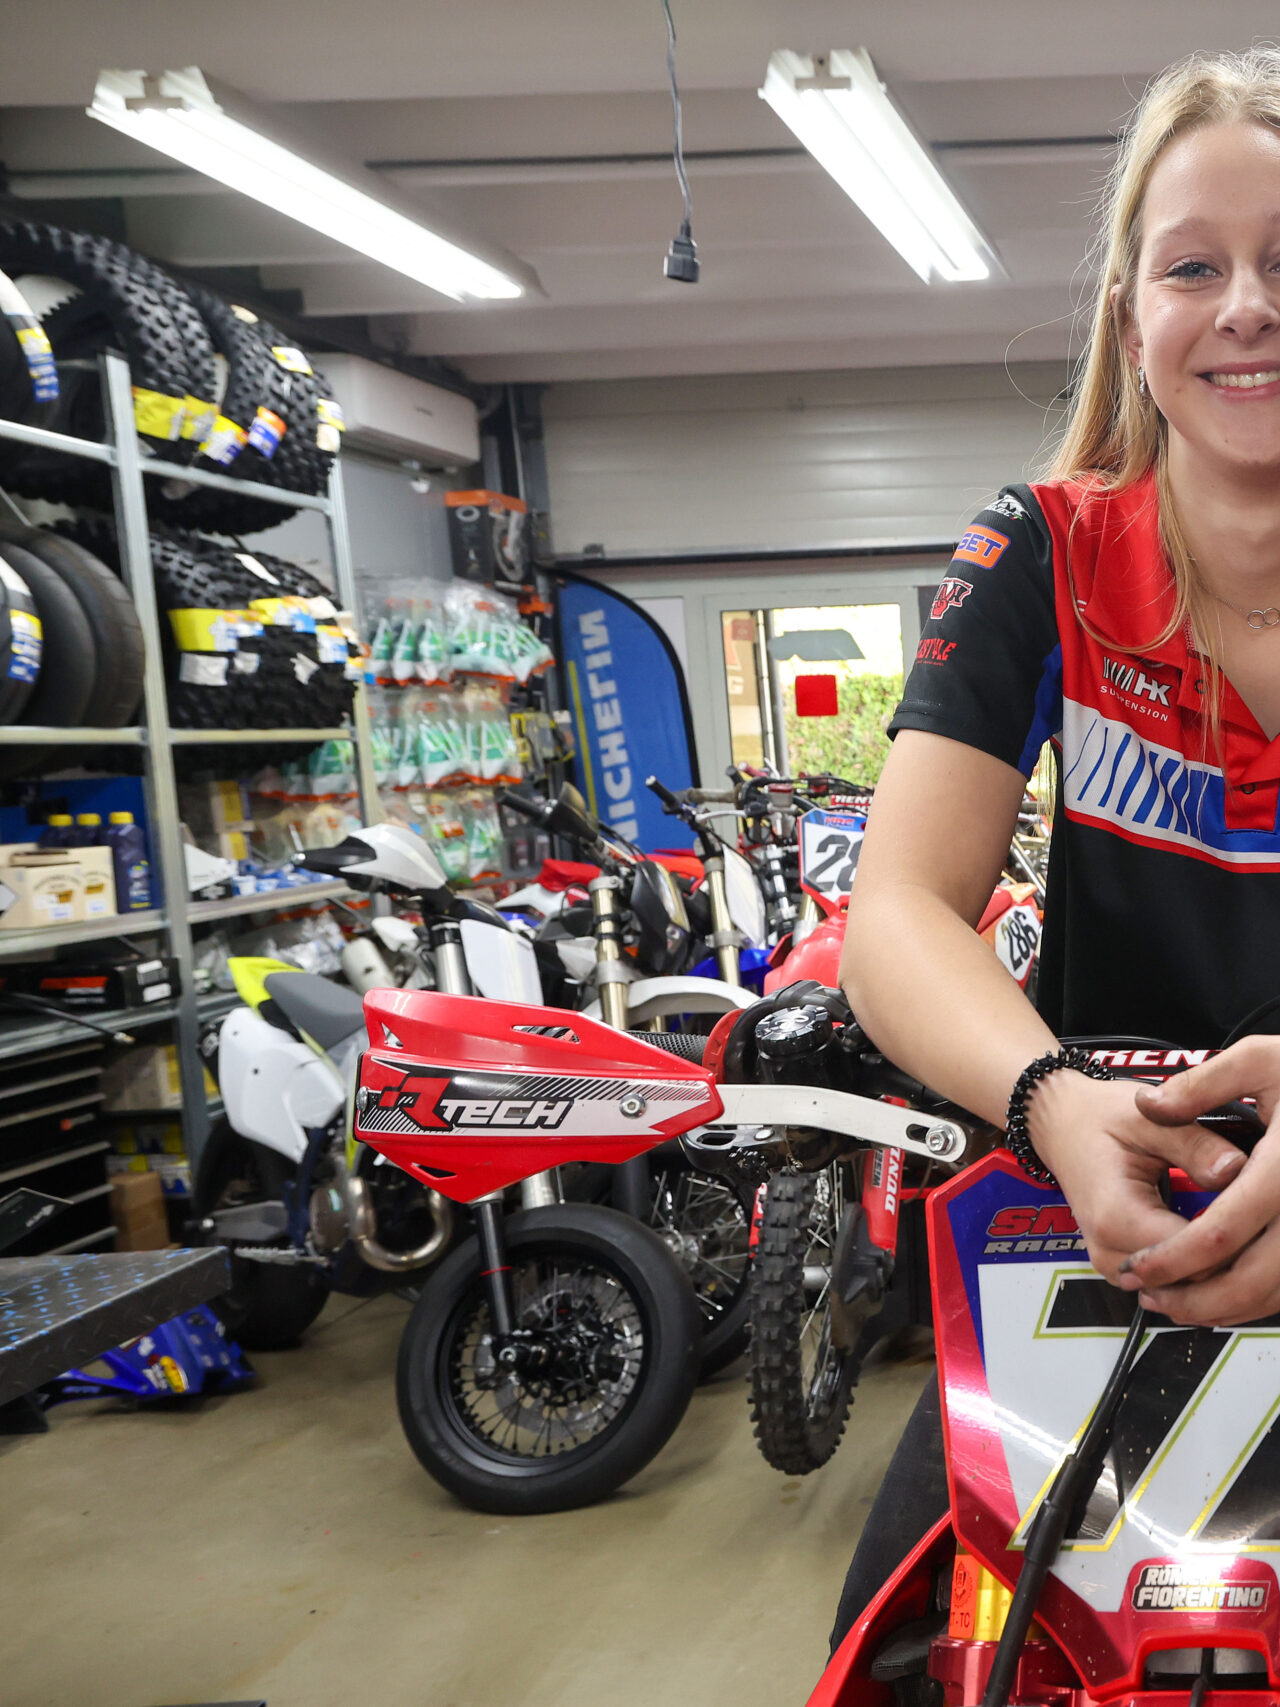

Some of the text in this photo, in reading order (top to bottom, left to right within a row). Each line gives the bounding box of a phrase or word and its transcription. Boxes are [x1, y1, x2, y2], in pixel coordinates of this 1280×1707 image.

[1001, 910, 1039, 972] 286
[987, 1206, 1084, 1238] SM
[1137, 1587, 1265, 1607] FIORENTINO
